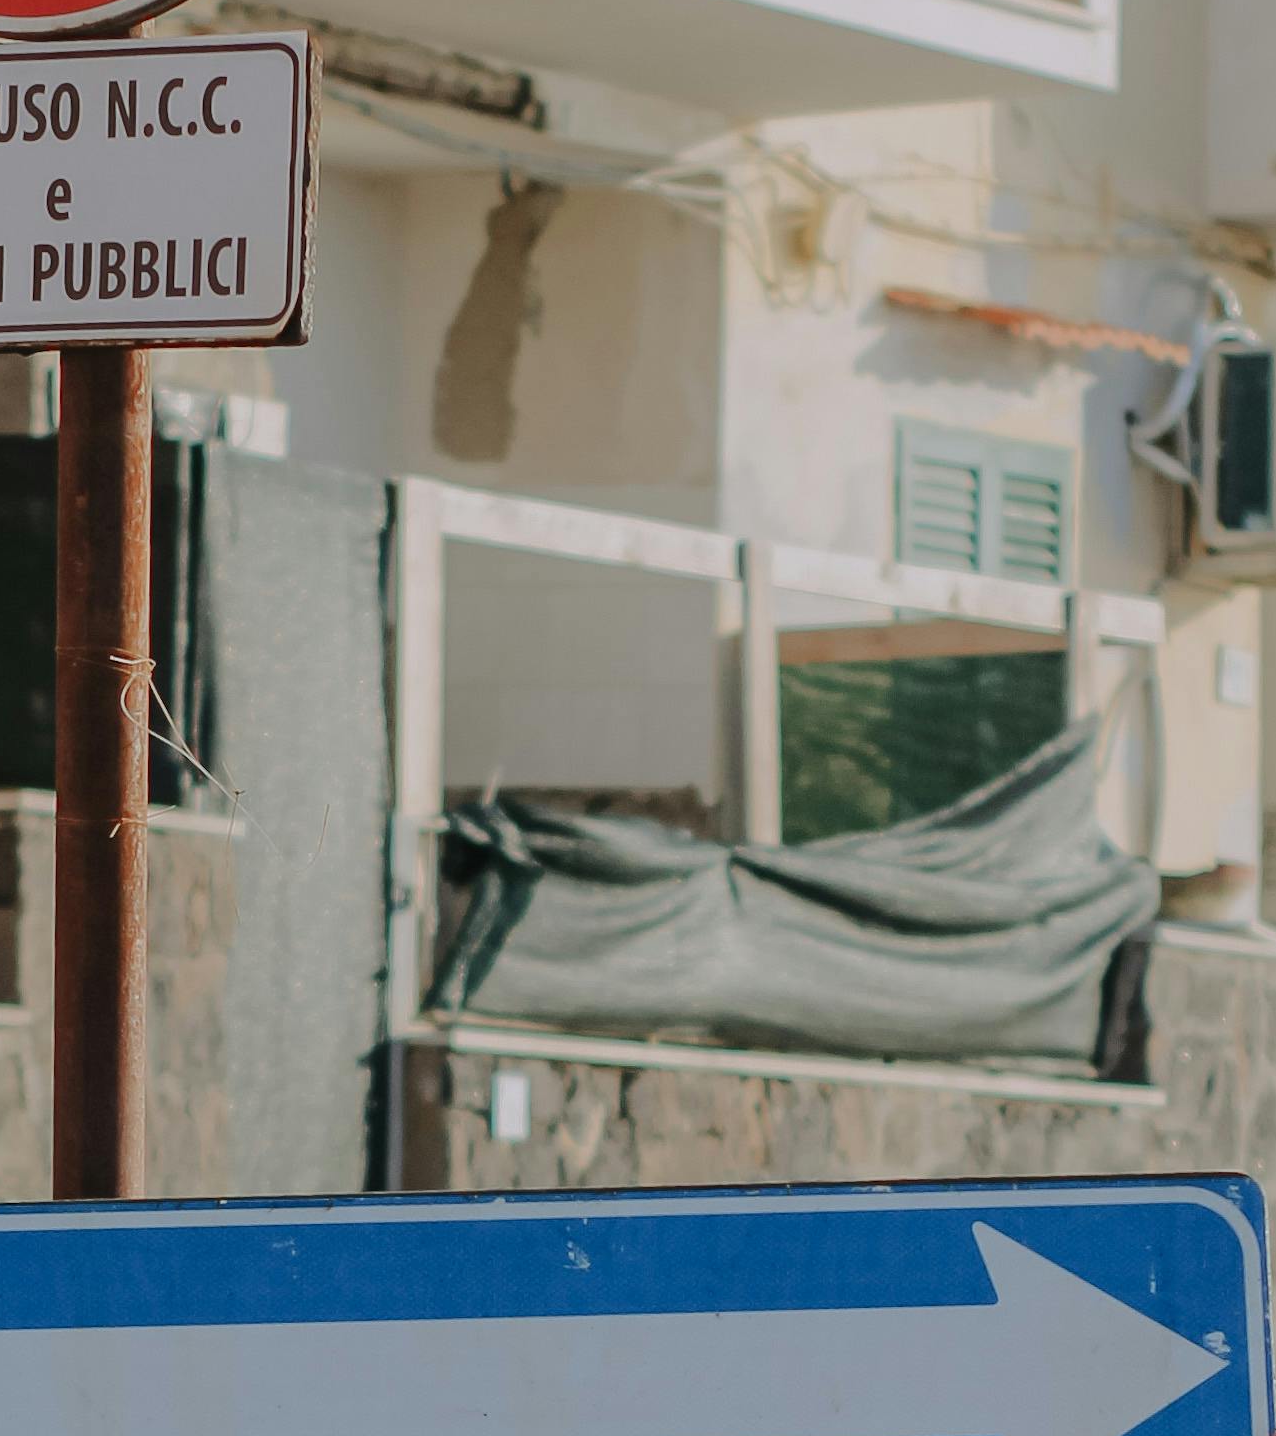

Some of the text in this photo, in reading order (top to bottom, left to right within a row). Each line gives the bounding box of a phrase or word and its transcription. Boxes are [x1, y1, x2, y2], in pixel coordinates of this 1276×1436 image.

[107, 76, 242, 140] N.C.C.
[46, 178, 72, 221] e
[32, 236, 247, 302] PUBBLICI
